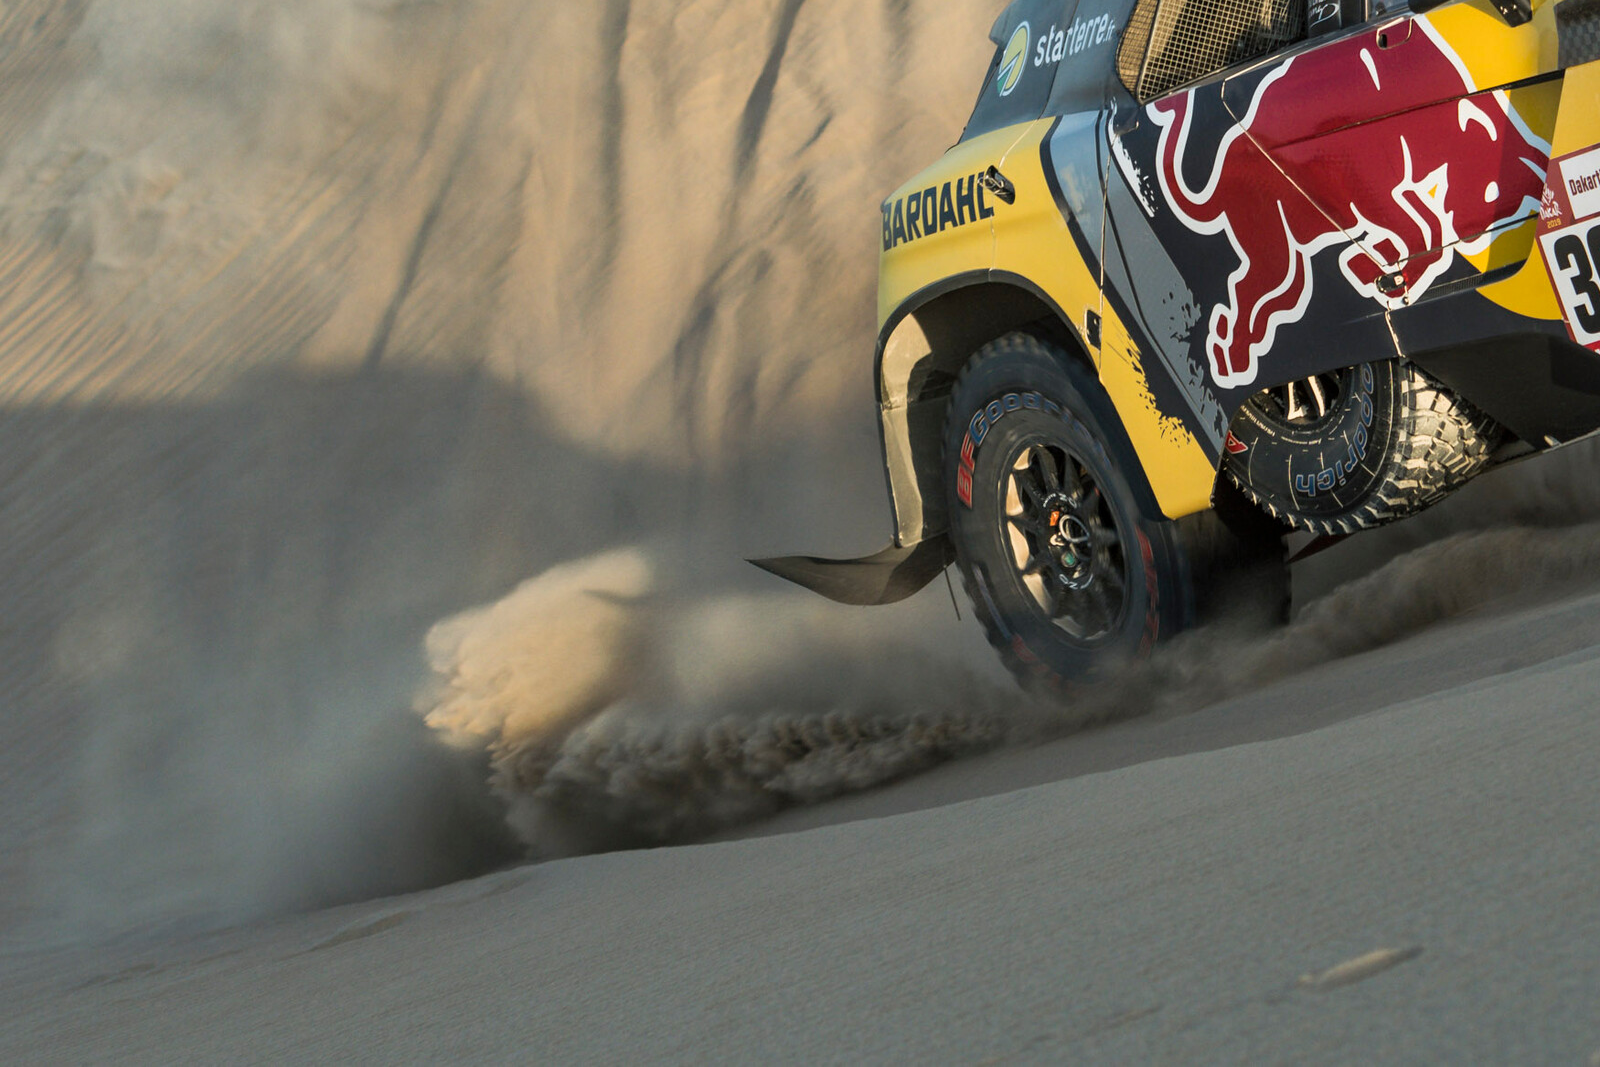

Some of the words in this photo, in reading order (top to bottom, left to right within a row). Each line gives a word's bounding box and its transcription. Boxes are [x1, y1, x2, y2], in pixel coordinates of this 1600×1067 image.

[1034, 13, 1115, 67] starterre.fr
[883, 171, 995, 252] BARDAHL
[1546, 217, 1562, 229] 2019
[1295, 362, 1374, 497] oodrich
